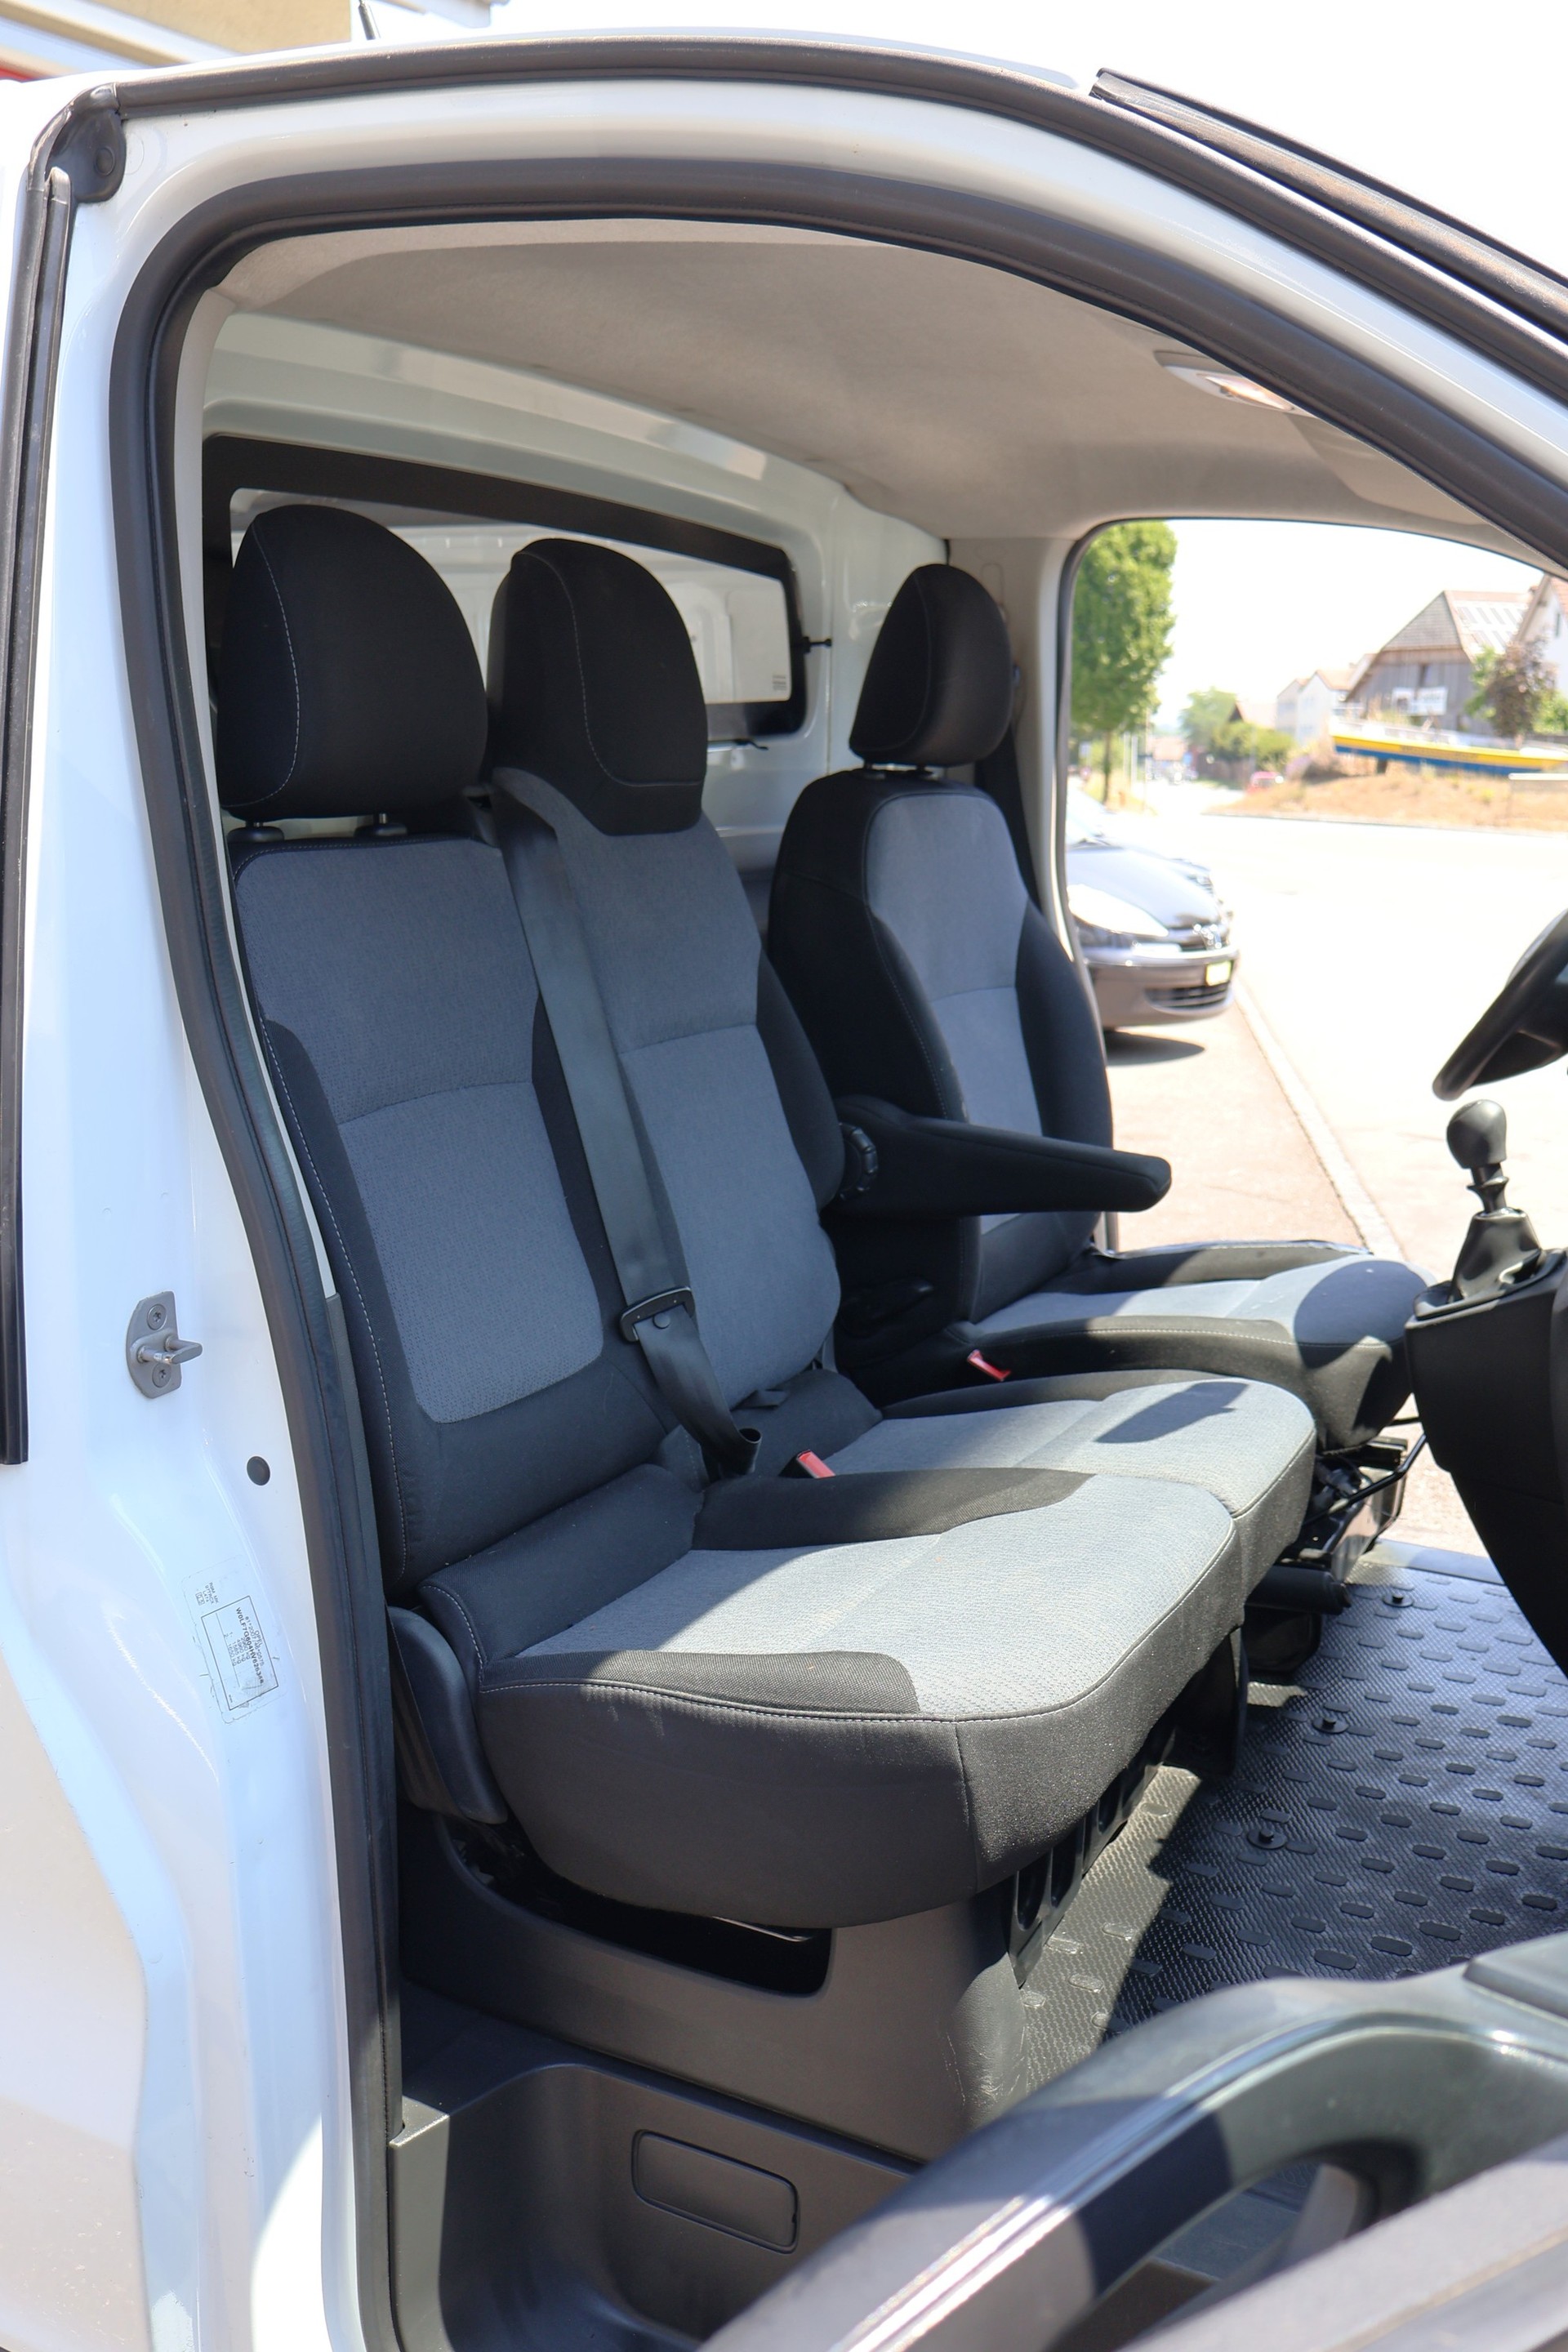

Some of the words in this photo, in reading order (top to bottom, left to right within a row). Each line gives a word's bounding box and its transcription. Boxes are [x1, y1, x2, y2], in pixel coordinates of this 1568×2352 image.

[254, 1629, 263, 1646] OPEL
[234, 1655, 243, 1664] kg
[239, 1653, 247, 1662] kg
[244, 1650, 251, 1660] kg
[230, 1657, 238, 1667] kg
